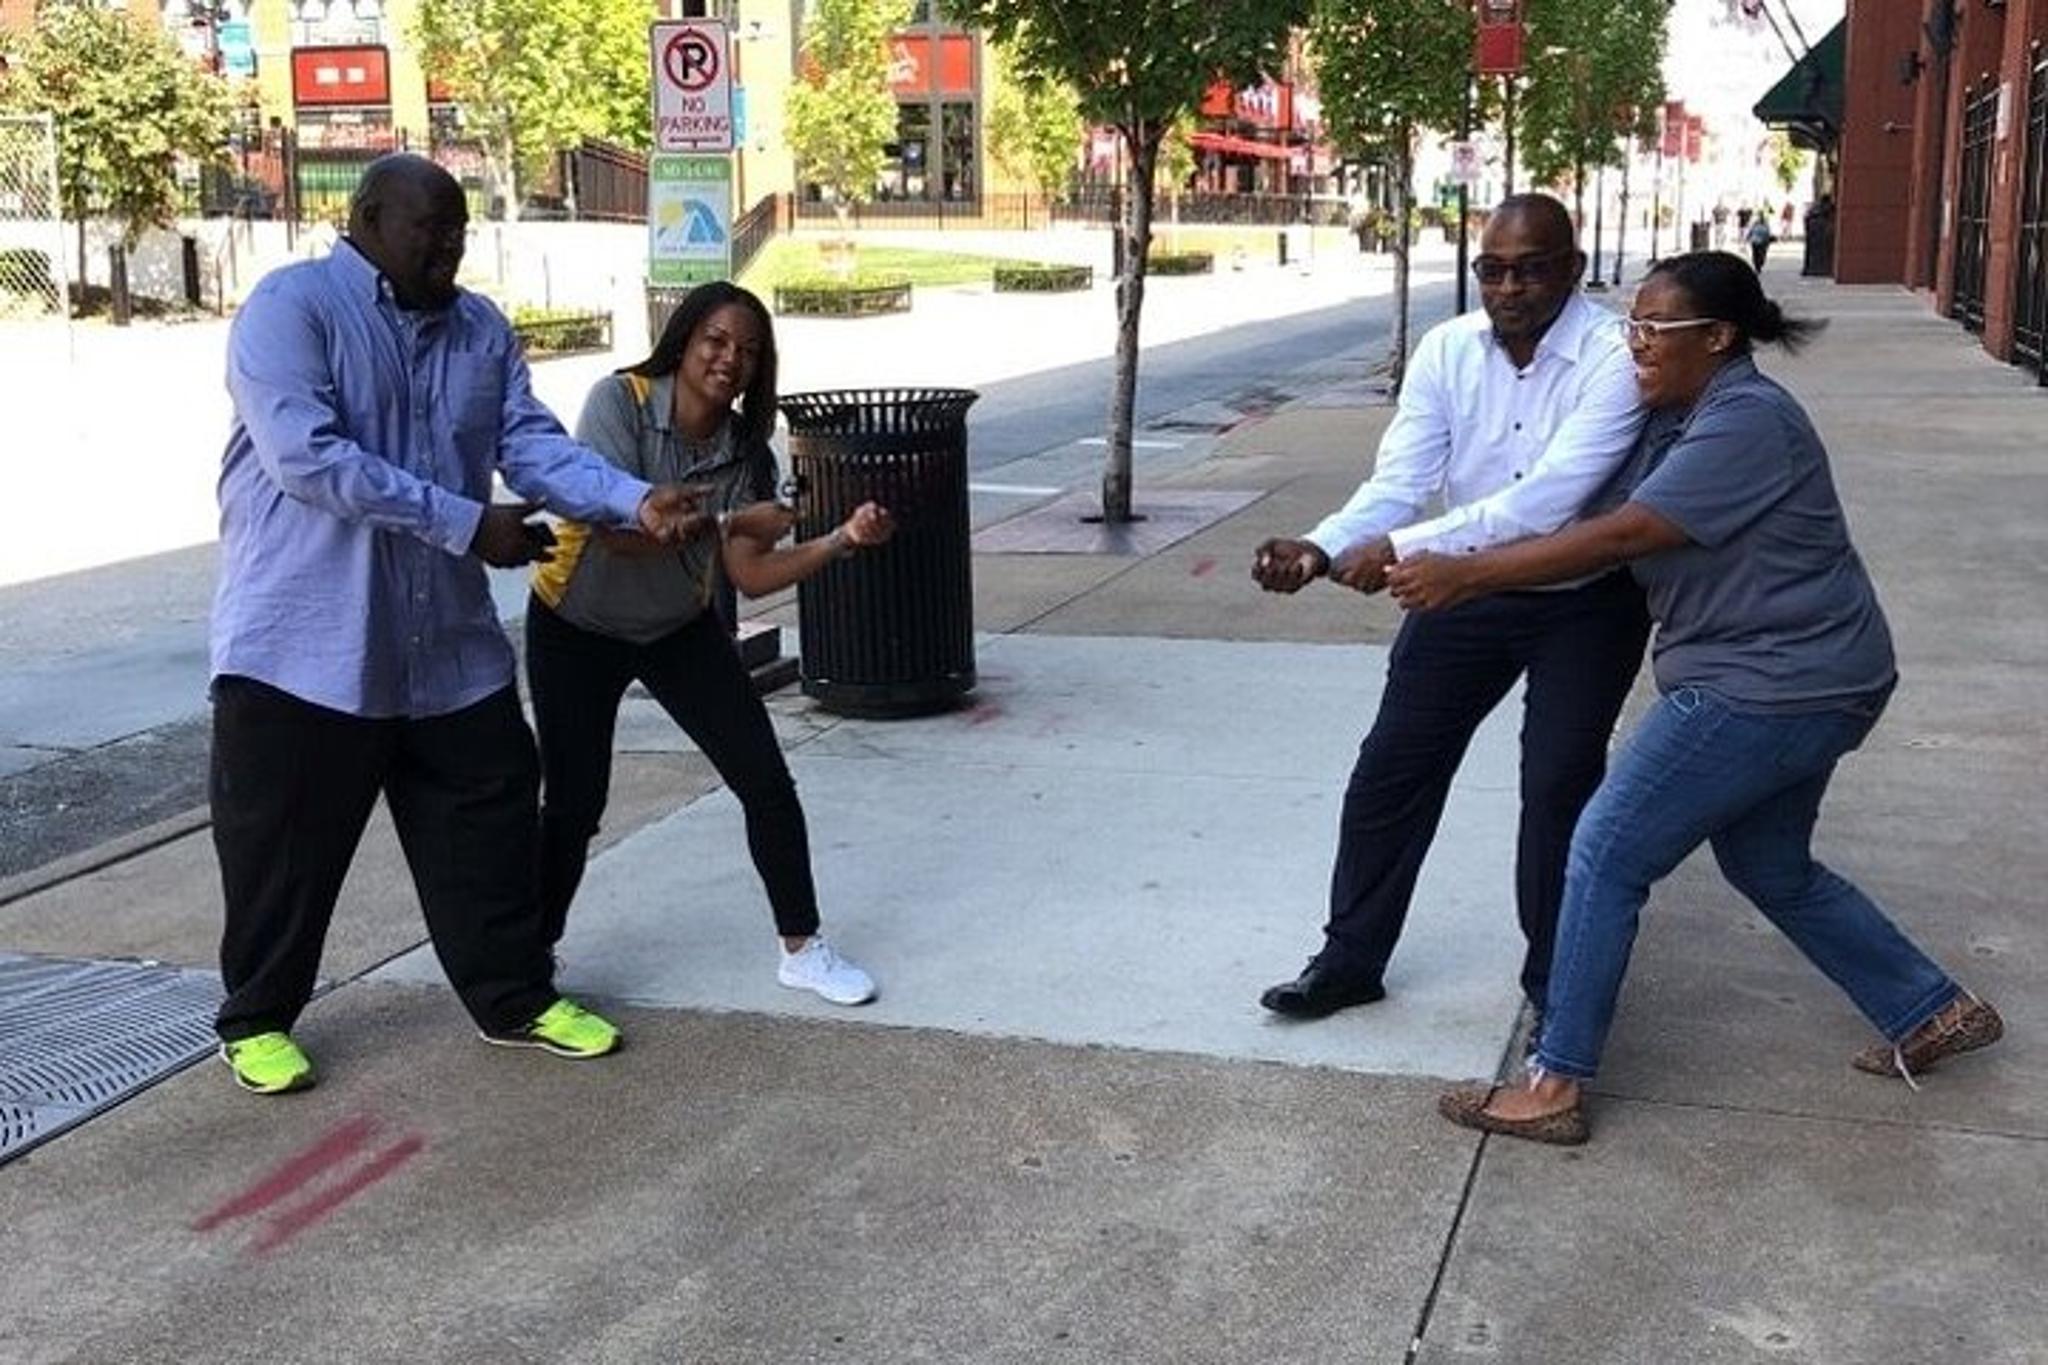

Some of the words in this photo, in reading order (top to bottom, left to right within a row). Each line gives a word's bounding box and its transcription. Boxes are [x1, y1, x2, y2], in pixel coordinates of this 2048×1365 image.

[682, 43, 708, 80] P
[682, 97, 706, 114] NO
[660, 118, 730, 135] PARKING
